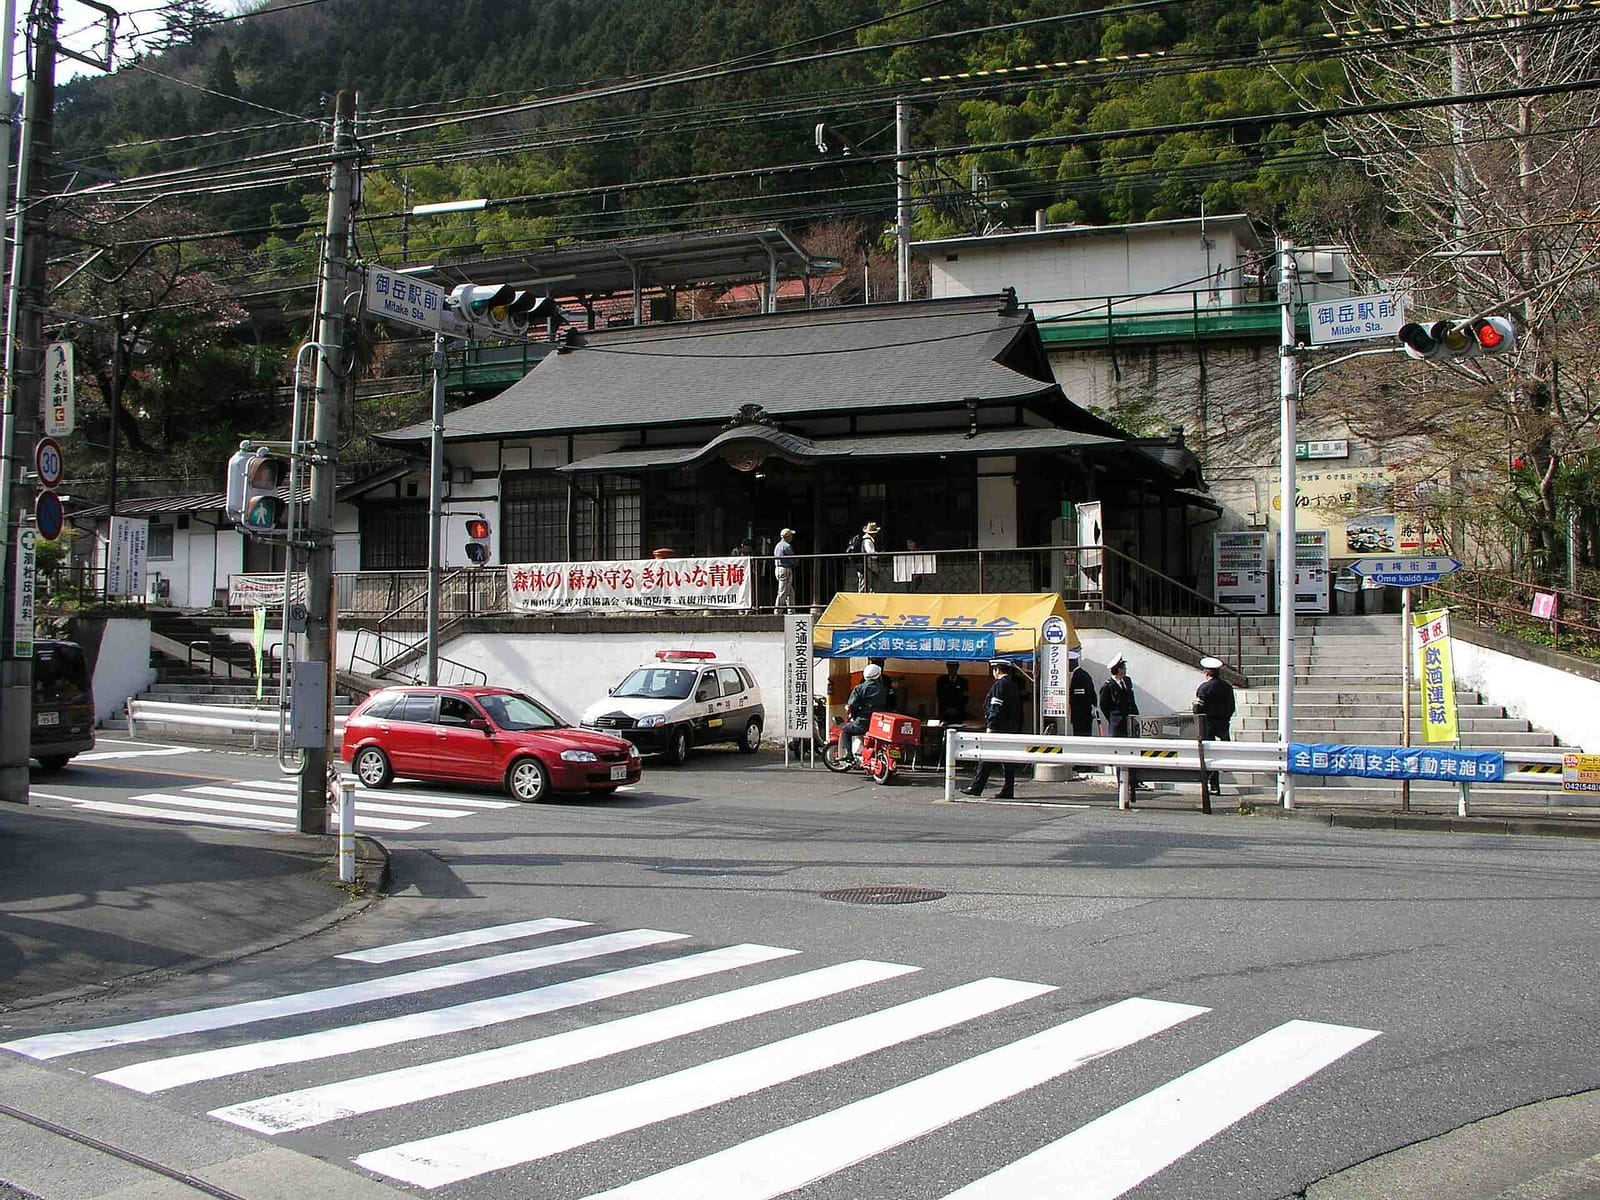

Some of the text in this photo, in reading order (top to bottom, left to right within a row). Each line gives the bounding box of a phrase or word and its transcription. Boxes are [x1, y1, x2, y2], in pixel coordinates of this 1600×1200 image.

[376, 274, 437, 311] 御岳駅前
[385, 299, 426, 321] Mitake Sta.
[1318, 300, 1395, 325] 御岳駅前
[1331, 322, 1383, 336] Mitake Sta.
[42, 451, 57, 475] 30
[513, 564, 745, 592] 森林の 緑が守る きれいな青梅
[1375, 561, 1437, 572] 青梅街道
[838, 637, 988, 651] 全国交通安全運動実施中
[795, 619, 808, 731] 交通安全街頭指導所
[1050, 646, 1059, 687] タクシーのりば
[1425, 647, 1448, 724] 飲酒運転
[1295, 751, 1496, 778] 全国交通安全運動実施中
